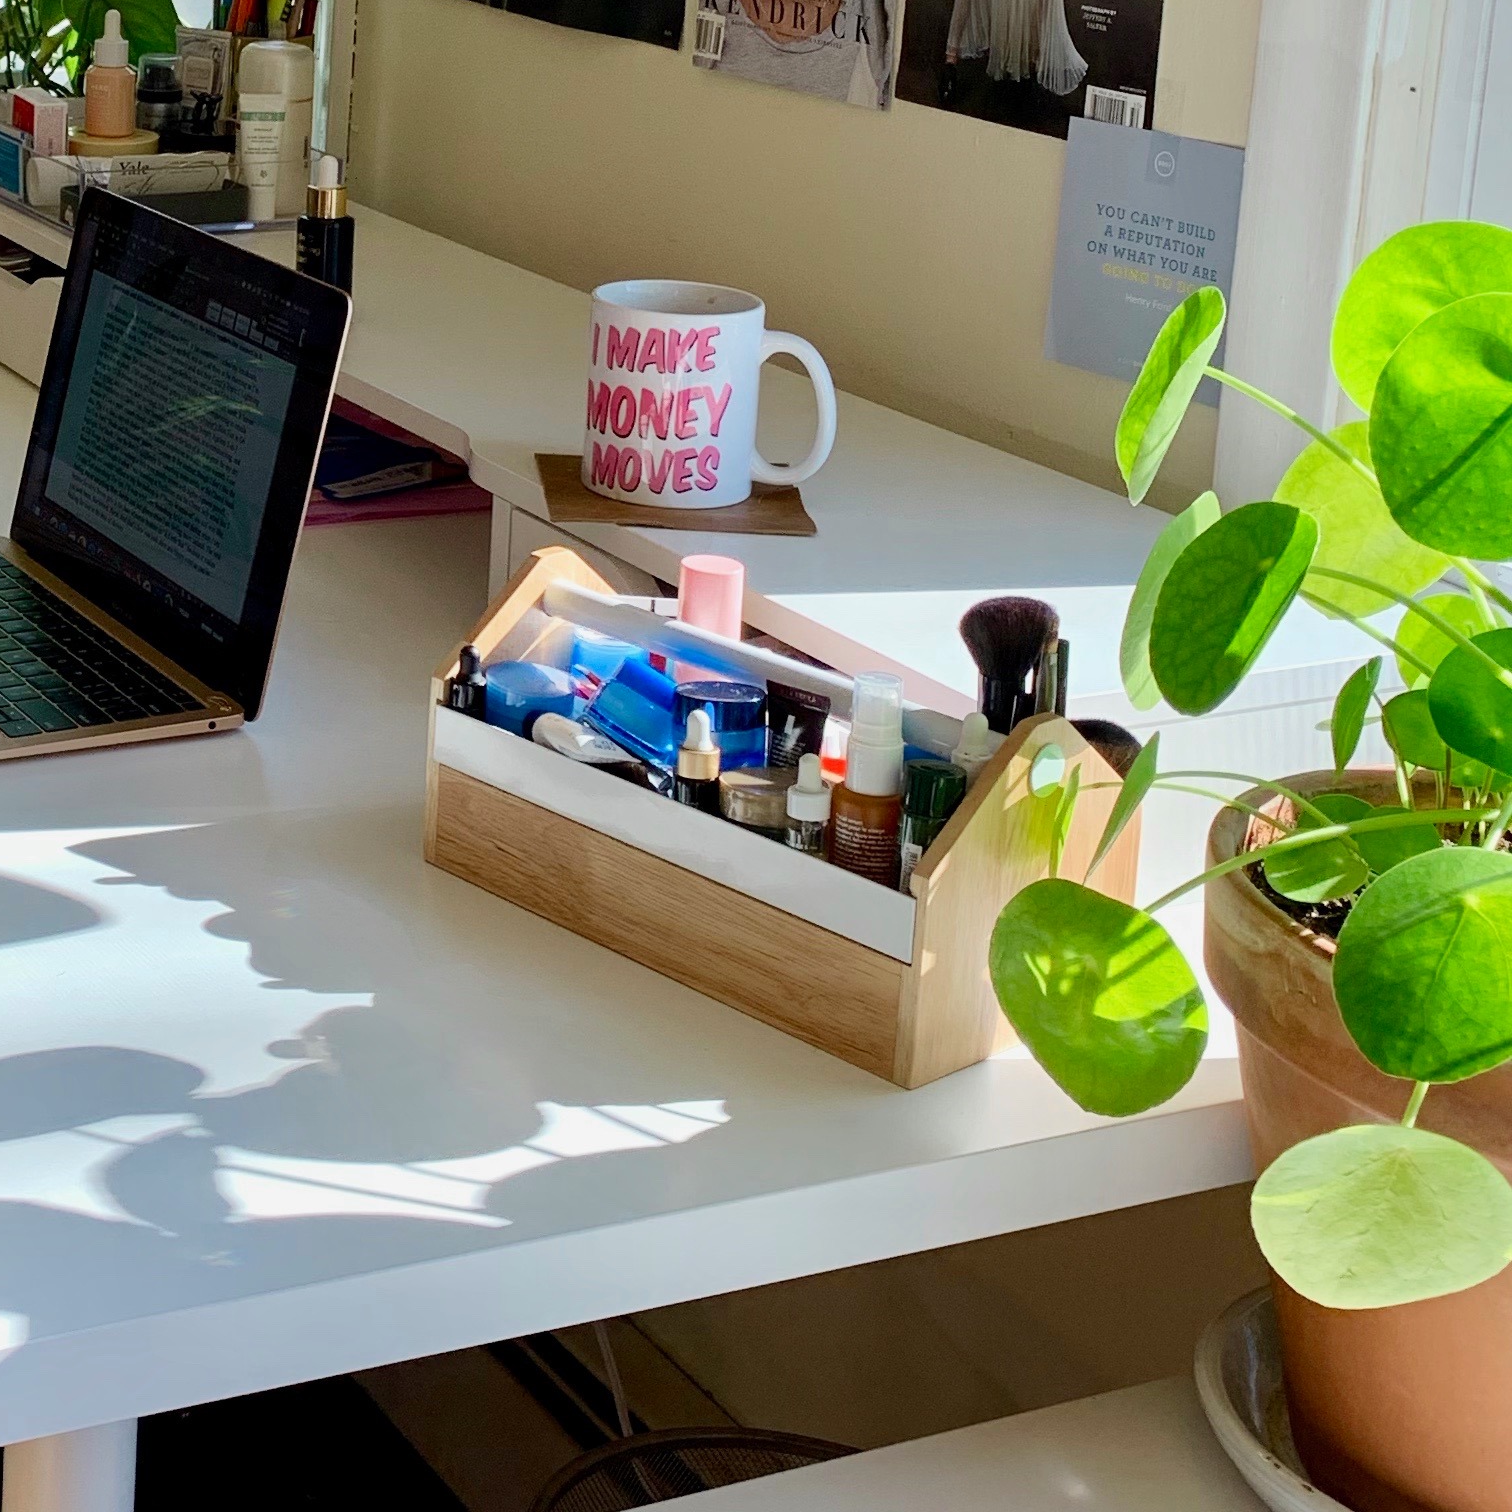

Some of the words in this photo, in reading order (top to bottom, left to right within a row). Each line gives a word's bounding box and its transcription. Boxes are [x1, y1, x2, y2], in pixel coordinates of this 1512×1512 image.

[119, 161, 150, 176] Yale
[1096, 203, 1125, 220] YOU
[1130, 211, 1174, 231] CAN'T
[1177, 220, 1216, 241] BUILD
[1104, 224, 1113, 238] A
[1117, 227, 1206, 258] REPUTATION
[1087, 240, 1108, 255] ON
[1112, 245, 1156, 266] WHAT
[1160, 256, 1189, 274] YOU
[1191, 265, 1218, 282] ARE
[592, 322, 600, 366] I
[606, 324, 721, 374] MAKE
[587, 378, 733, 441] MONEY
[591, 441, 721, 494] MOVES
